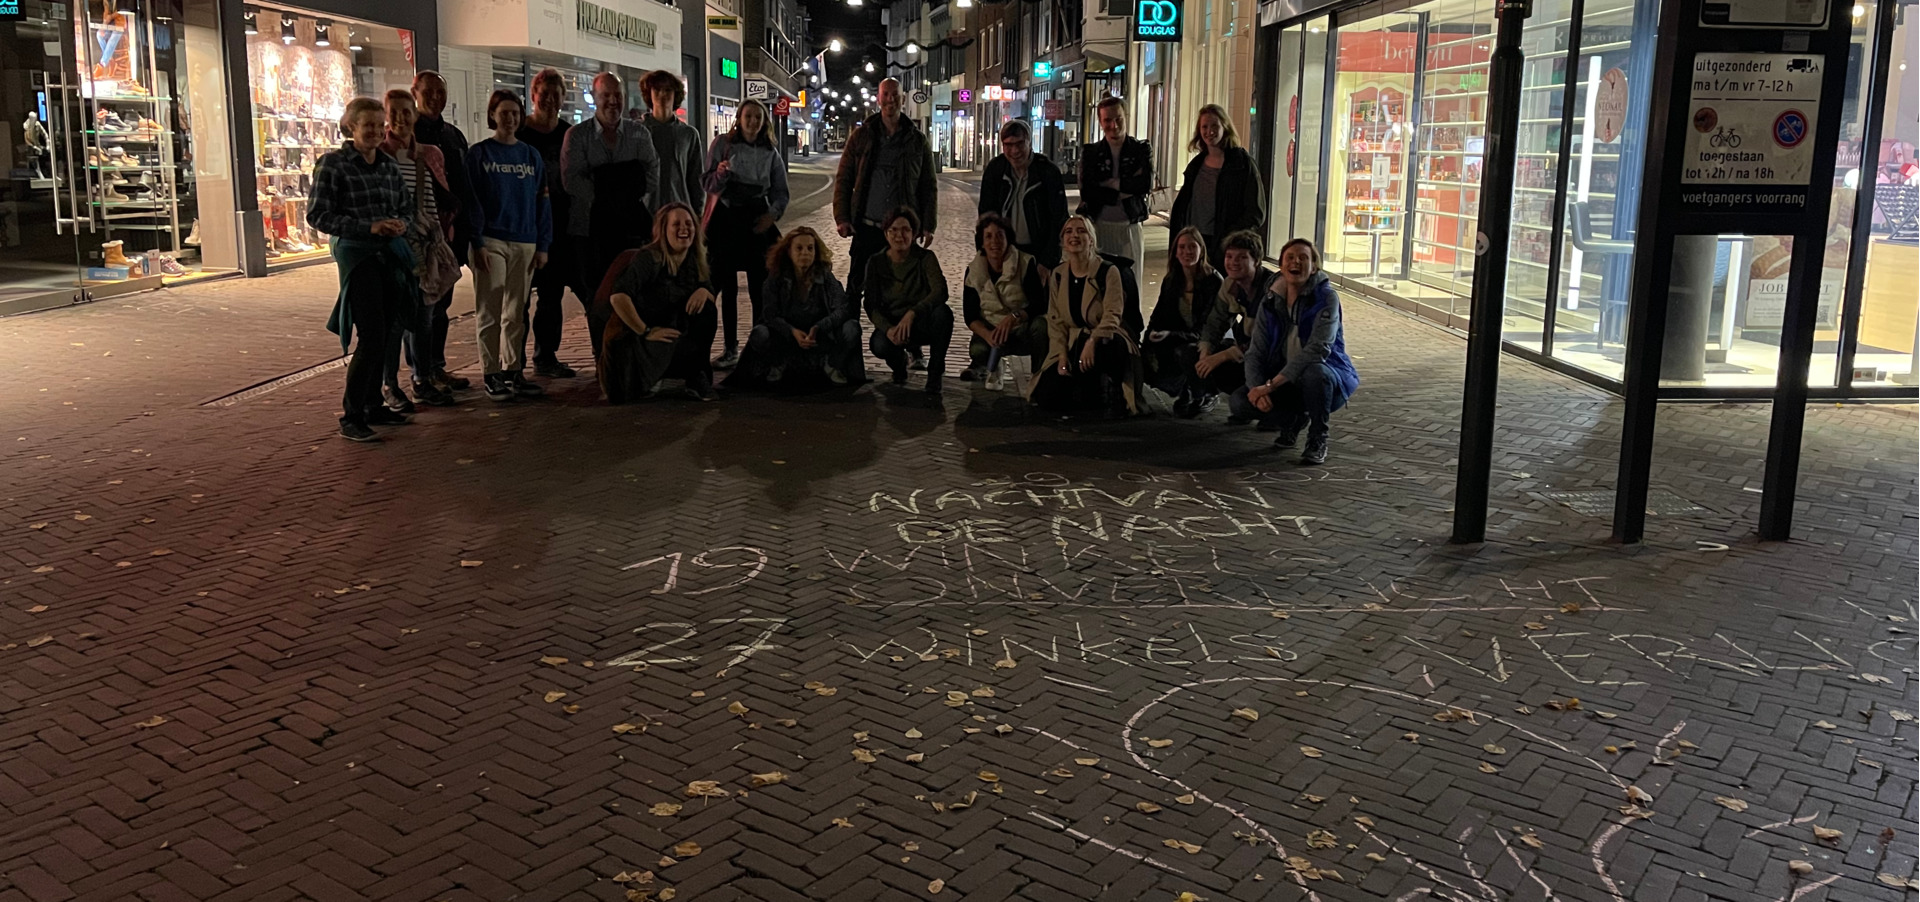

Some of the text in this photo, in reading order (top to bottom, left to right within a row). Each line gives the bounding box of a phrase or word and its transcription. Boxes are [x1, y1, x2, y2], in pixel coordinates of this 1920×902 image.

[1138, 25, 1176, 36] DOUGLAS
[1695, 60, 1772, 75] uitgezonderd
[749, 83, 766, 93] Etos
[1693, 81, 1711, 92] ma
[1743, 81, 1756, 92] vr
[1758, 79, 1784, 92] 7-12
[1786, 80, 1793, 92] h
[1699, 151, 1764, 164] toegestaan
[481, 160, 535, 180] Wrangler
[1685, 169, 1701, 179] tot
[1735, 171, 1750, 179] na
[1755, 168, 1774, 180] 18h
[1682, 191, 1805, 207] voetgangers voorrang
[1758, 283, 1785, 293] JOB
[1051, 511, 1325, 542] NACHT
[621, 541, 1340, 595] 19 WINKELS
[606, 617, 791, 670] 27
